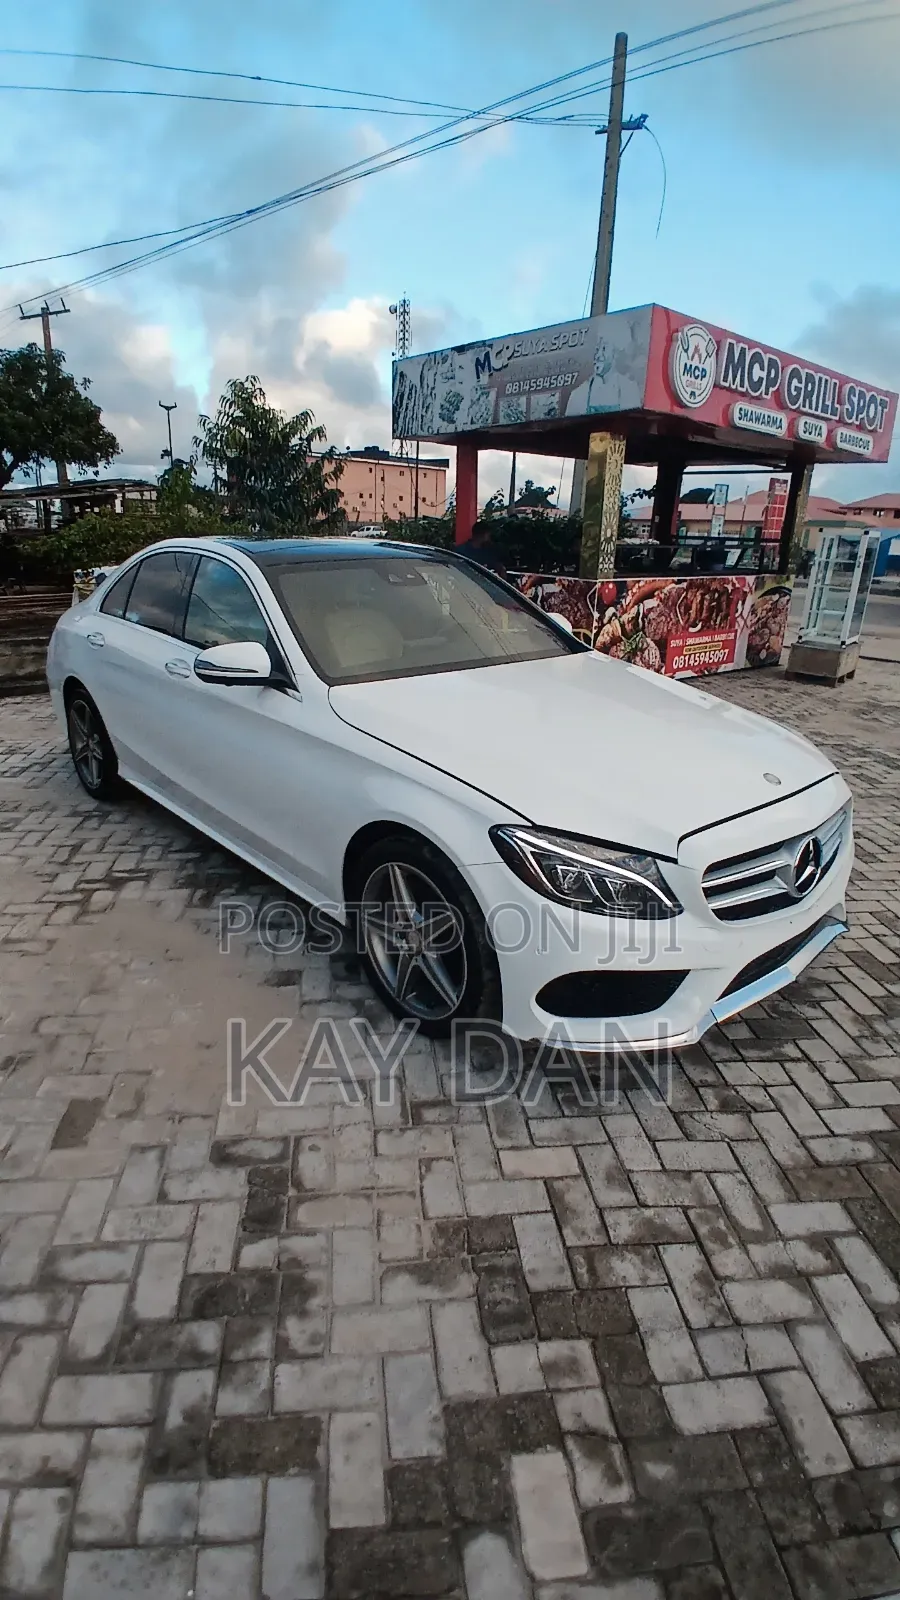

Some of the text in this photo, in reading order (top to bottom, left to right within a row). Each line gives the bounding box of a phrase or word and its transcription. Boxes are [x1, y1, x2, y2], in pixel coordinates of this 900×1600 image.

[514, 339, 548, 358] SUYA
[549, 327, 589, 351] SPOT
[682, 362, 707, 381] MCP
[505, 372, 579, 394] 08145945097
[722, 339, 889, 432] MCP GRILL SPOT
[738, 408, 783, 430] SHAWARMA
[803, 421, 823, 438] SUYA
[840, 432, 870, 449] BARBECUE
[672, 649, 729, 669] 08145945097
